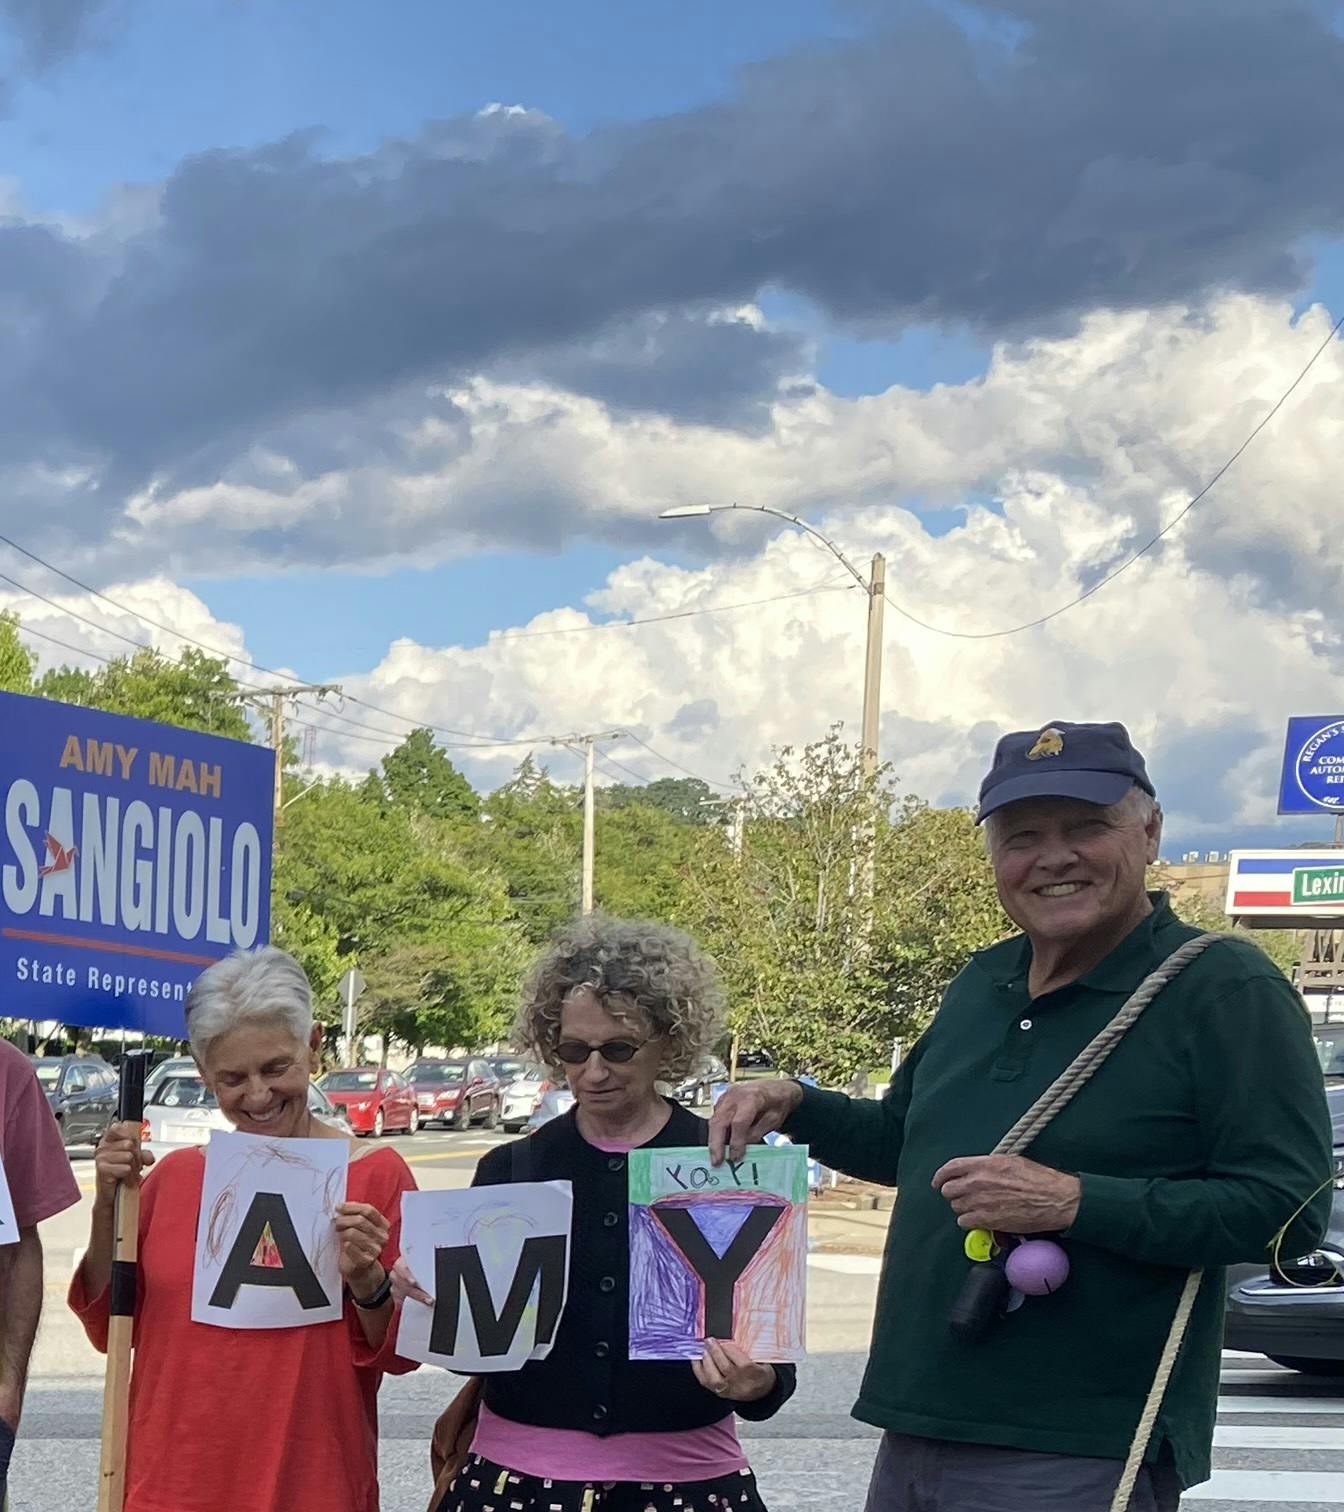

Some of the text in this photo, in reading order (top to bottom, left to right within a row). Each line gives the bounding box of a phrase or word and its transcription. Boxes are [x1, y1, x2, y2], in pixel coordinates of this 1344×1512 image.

[59, 735, 222, 798] AMY MAH
[1, 778, 261, 950] SANGIOLO
[16, 957, 77, 987] State
[207, 1191, 331, 1311] A
[428, 1233, 568, 1358] M
[650, 1205, 787, 1341] Y
